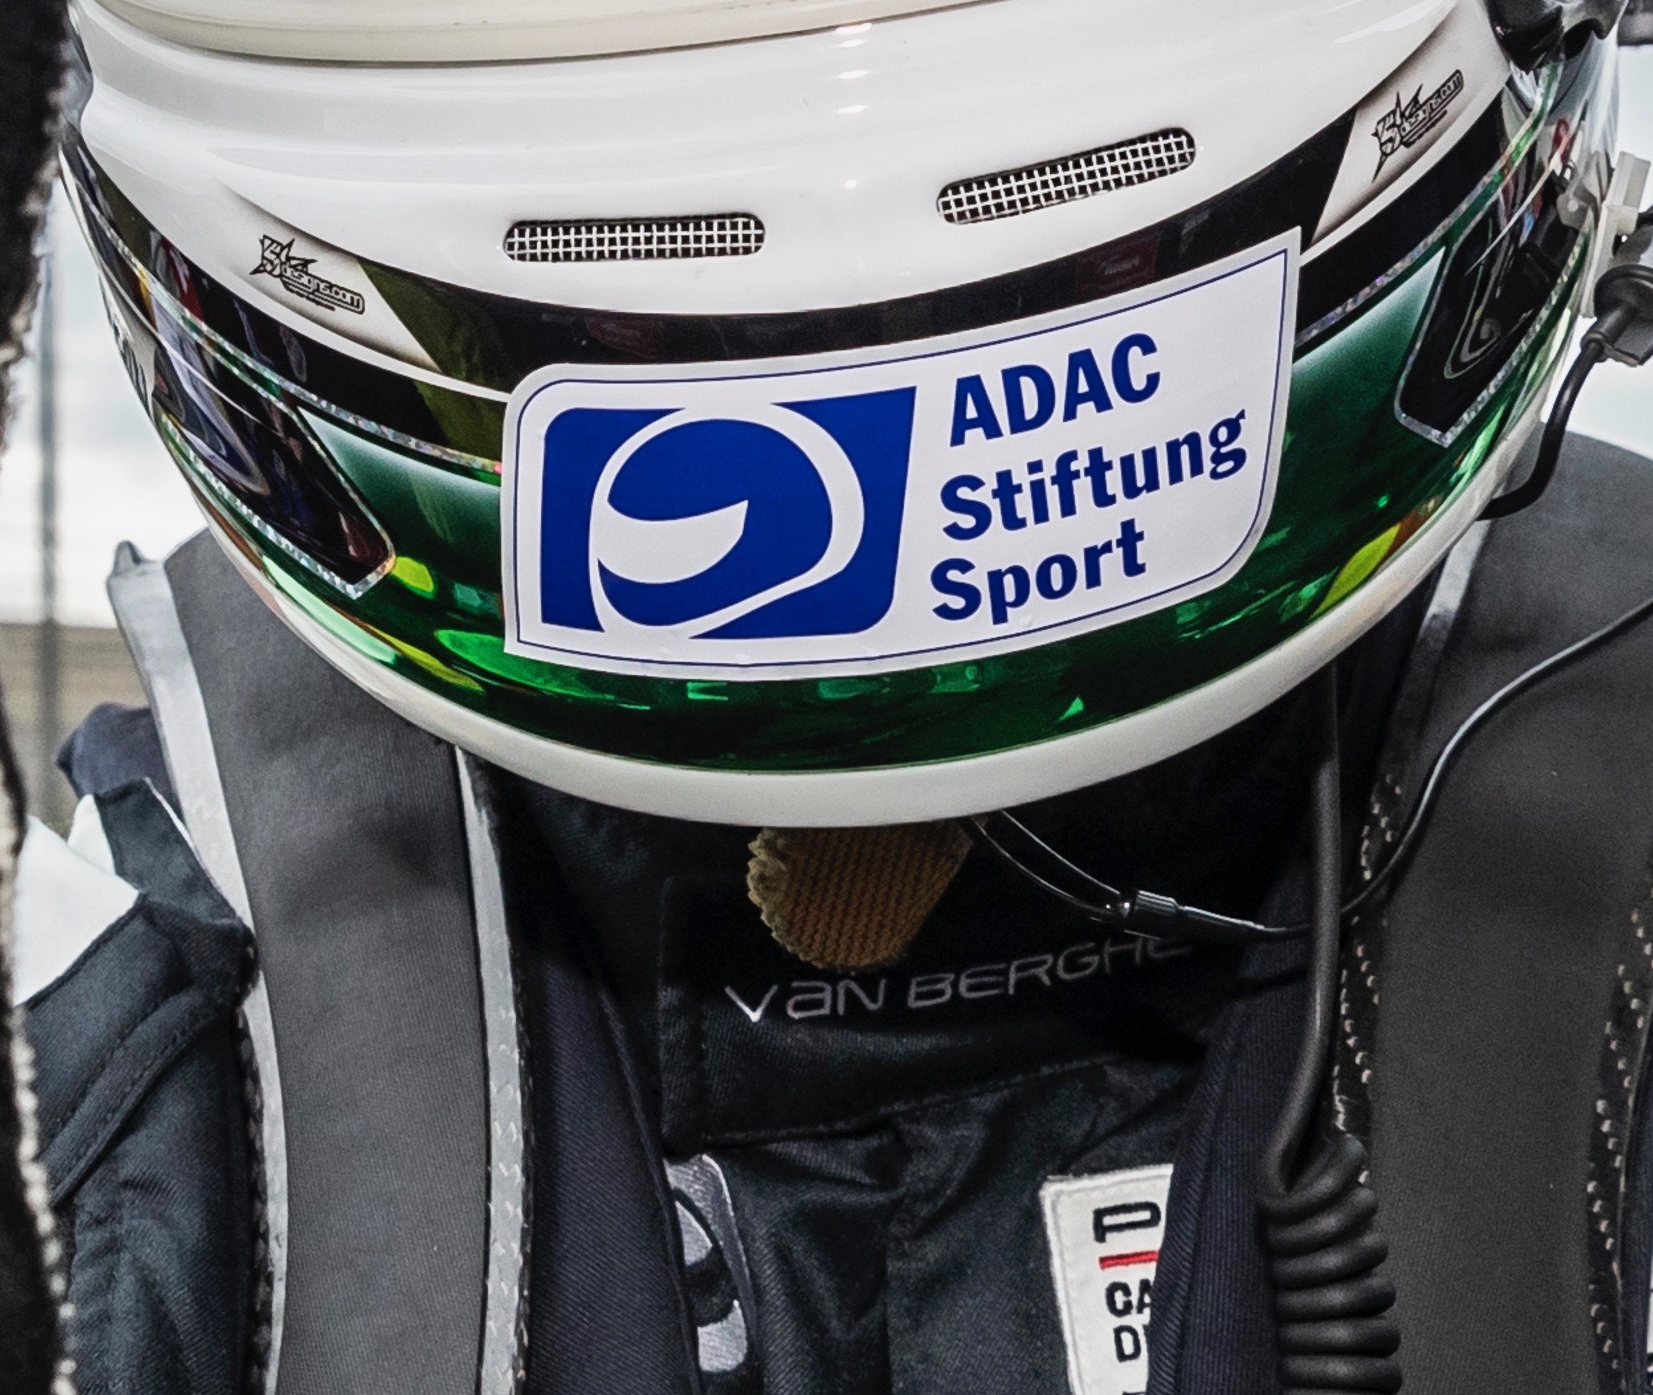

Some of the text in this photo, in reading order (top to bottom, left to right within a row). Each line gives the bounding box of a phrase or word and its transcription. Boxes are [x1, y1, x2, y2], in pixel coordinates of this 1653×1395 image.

[950, 333, 1161, 447] ADAC
[940, 408, 1247, 541] Stiftung
[930, 518, 1147, 626] Sport
